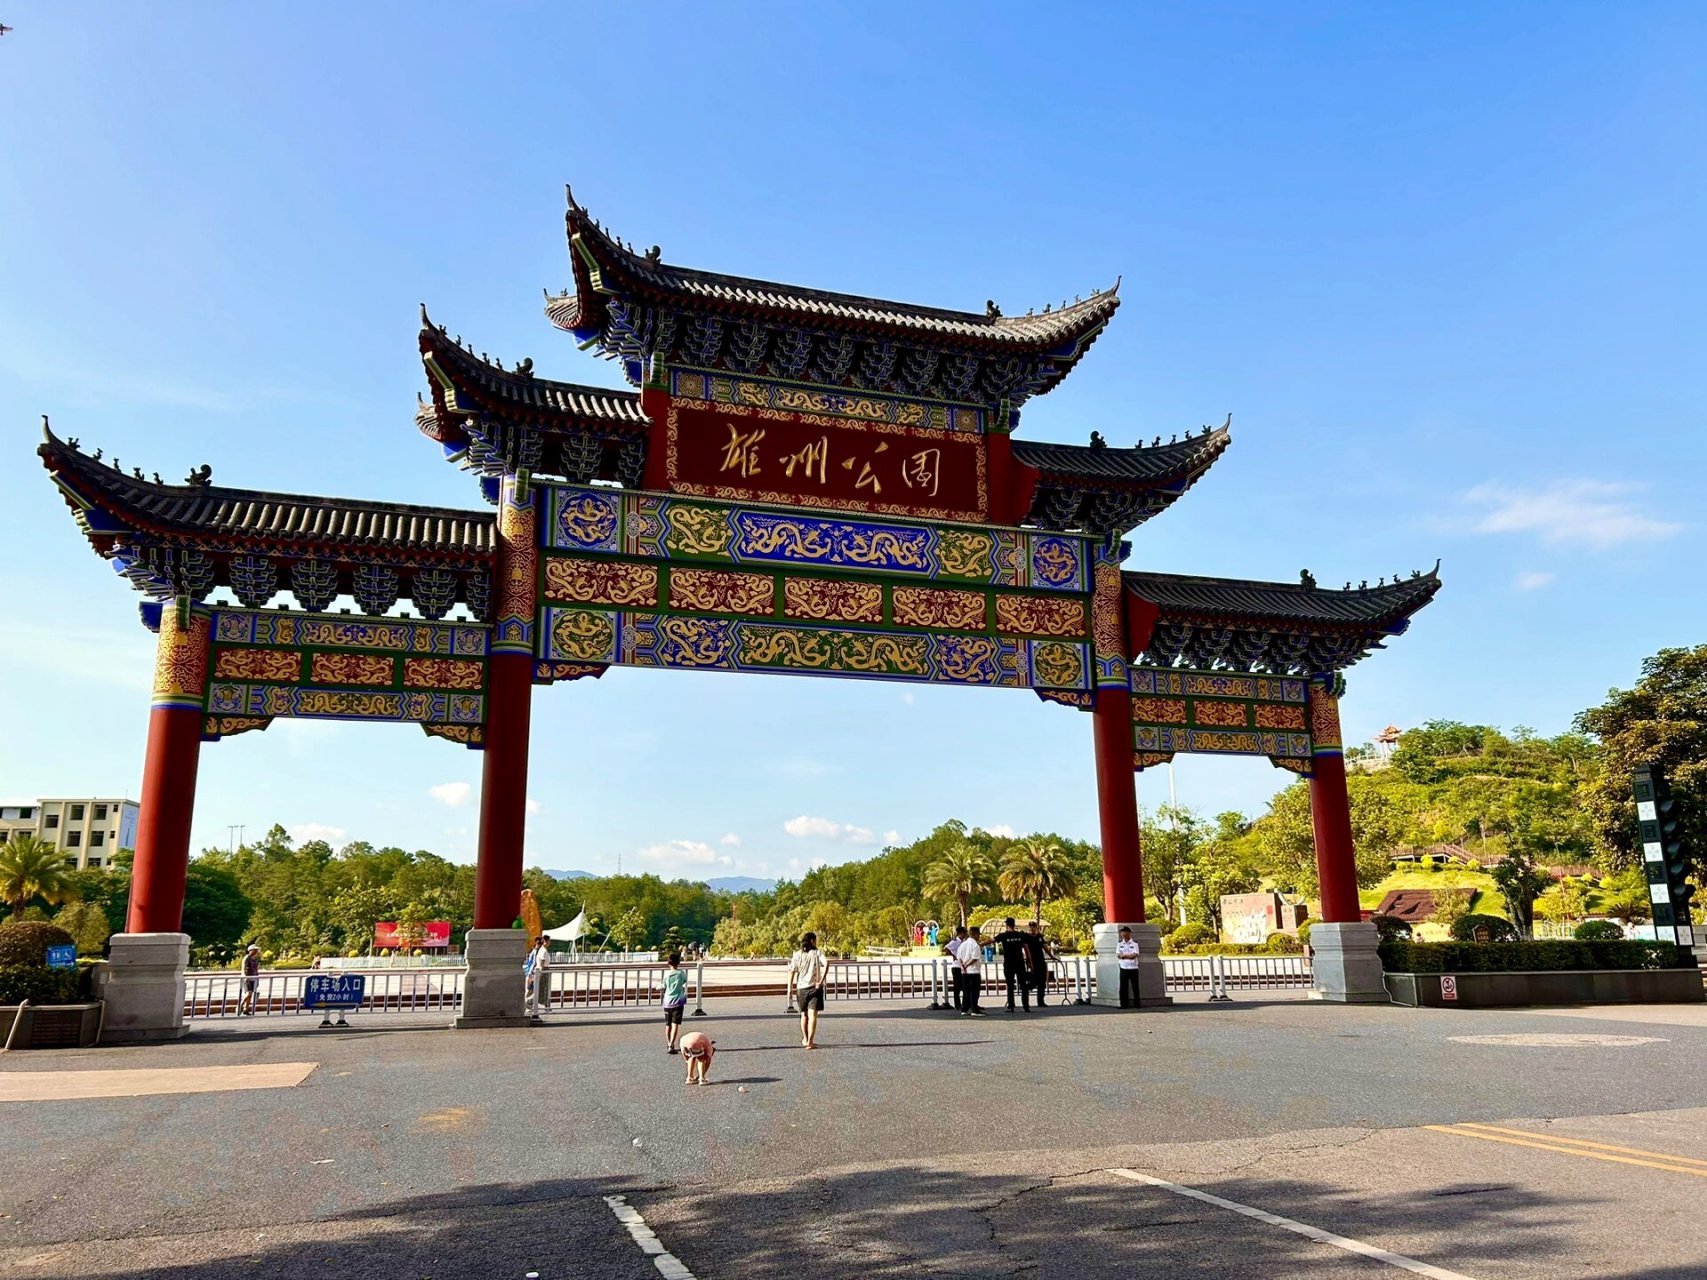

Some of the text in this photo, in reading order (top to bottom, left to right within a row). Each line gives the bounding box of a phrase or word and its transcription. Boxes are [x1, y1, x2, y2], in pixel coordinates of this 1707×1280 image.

[310, 978, 360, 992] 停车场入口
